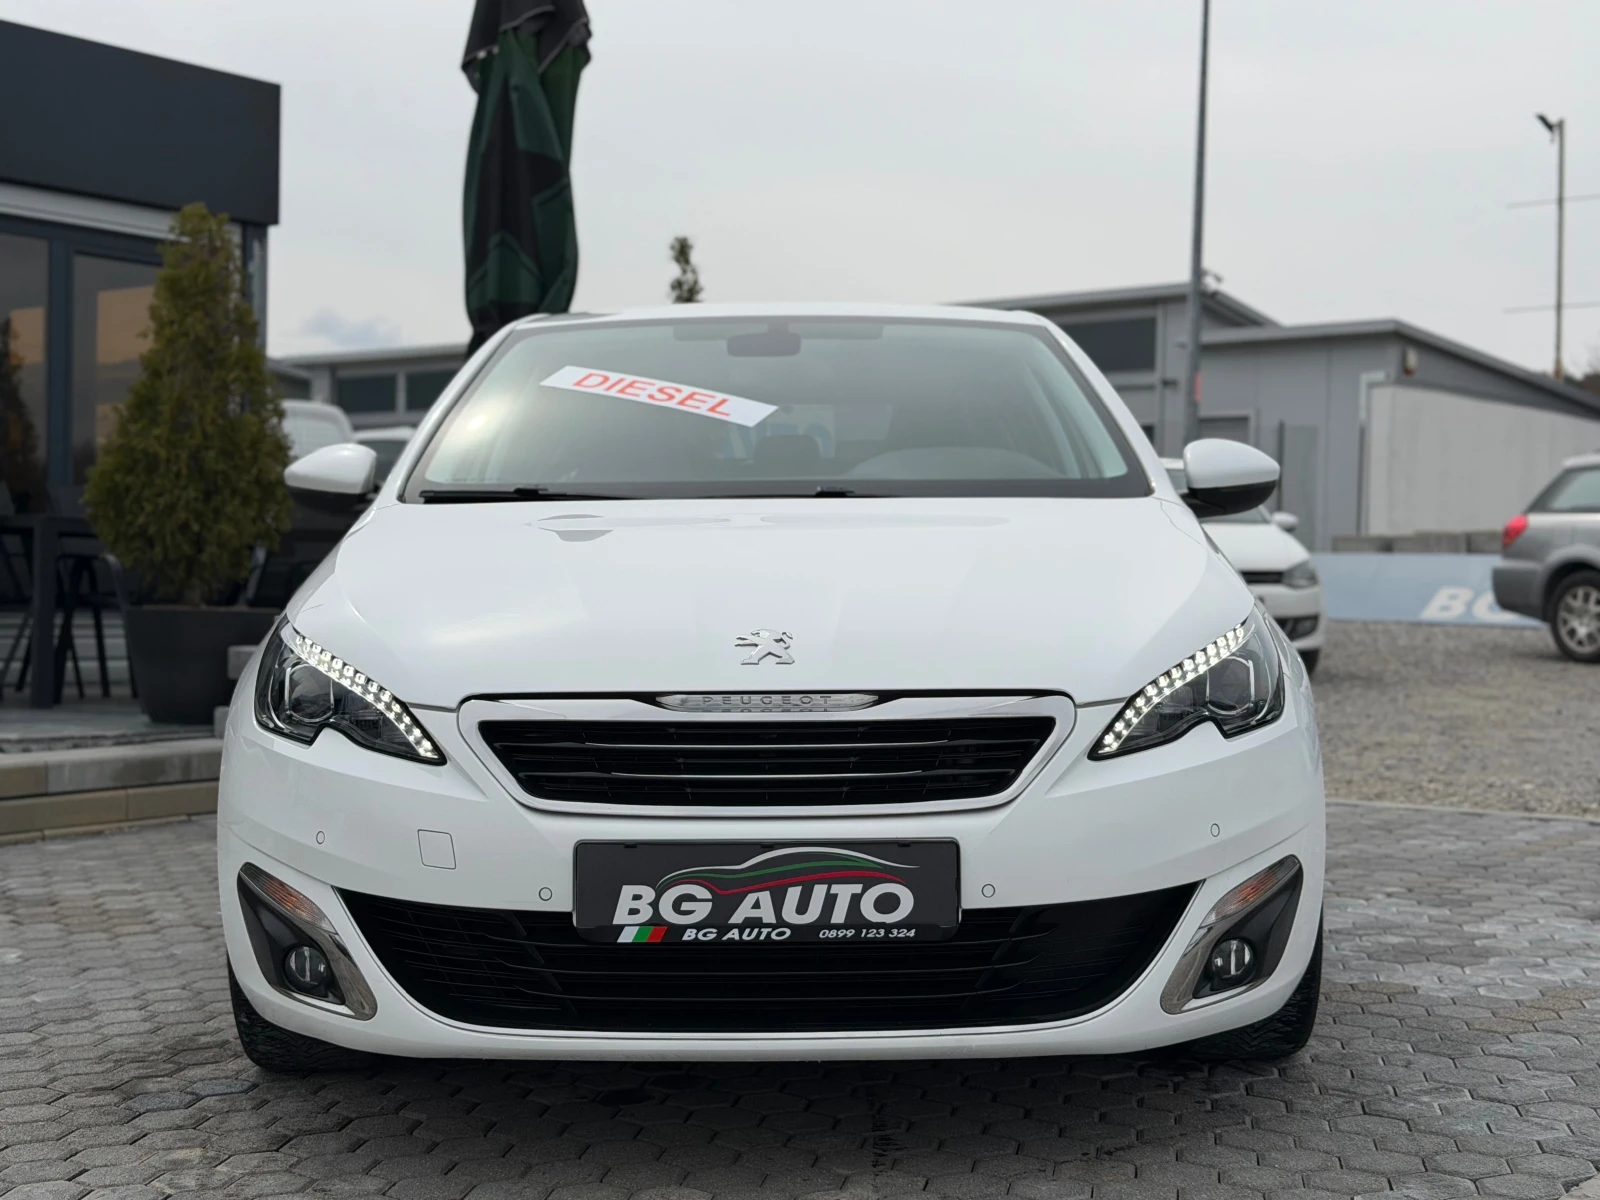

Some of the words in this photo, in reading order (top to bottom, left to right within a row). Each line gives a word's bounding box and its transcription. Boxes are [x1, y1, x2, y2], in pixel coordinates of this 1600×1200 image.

[573, 372, 732, 417] DIESEL
[702, 695, 832, 706] PEUGEOT
[612, 884, 713, 925] BG
[728, 883, 915, 925] AUTO
[681, 928, 718, 941] BG
[721, 927, 792, 941] AUTO
[819, 929, 855, 938] 0899
[860, 928, 886, 938] 123
[888, 928, 916, 938] 324
